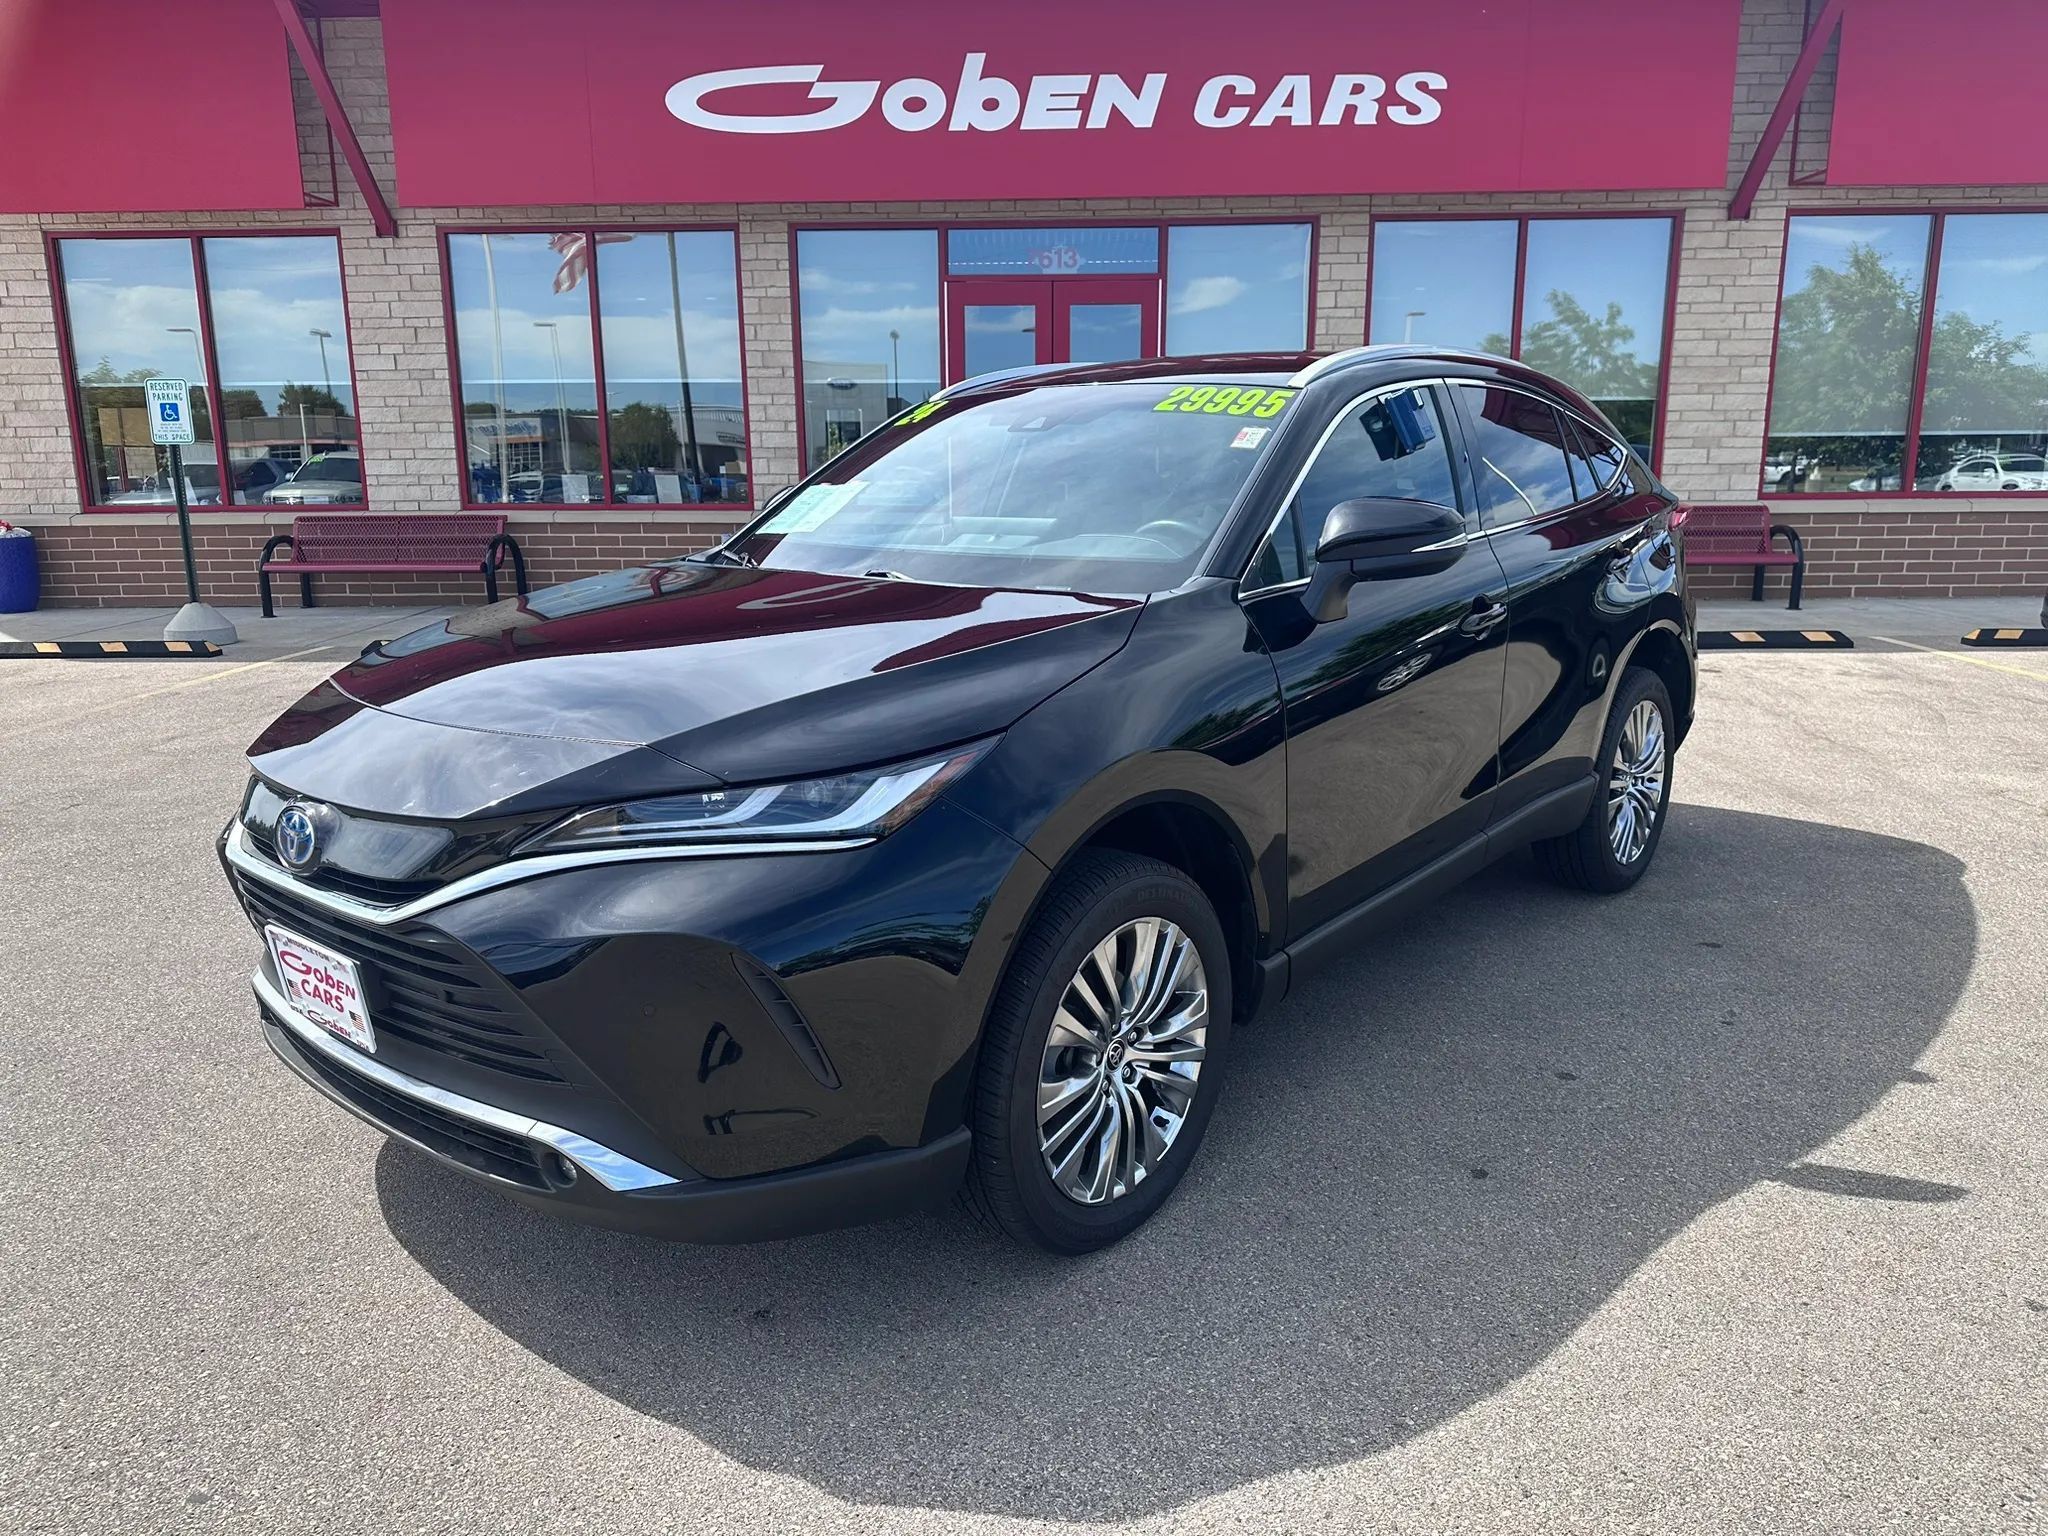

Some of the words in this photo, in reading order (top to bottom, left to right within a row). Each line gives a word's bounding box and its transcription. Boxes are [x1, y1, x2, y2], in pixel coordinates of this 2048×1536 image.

[1194, 71, 1448, 126] CARS
[1039, 249, 1078, 269] 613
[150, 382, 183, 391] RESERVED
[153, 393, 183, 401] PARKING
[1153, 386, 1293, 418] 29995
[301, 978, 344, 1013] CARS
